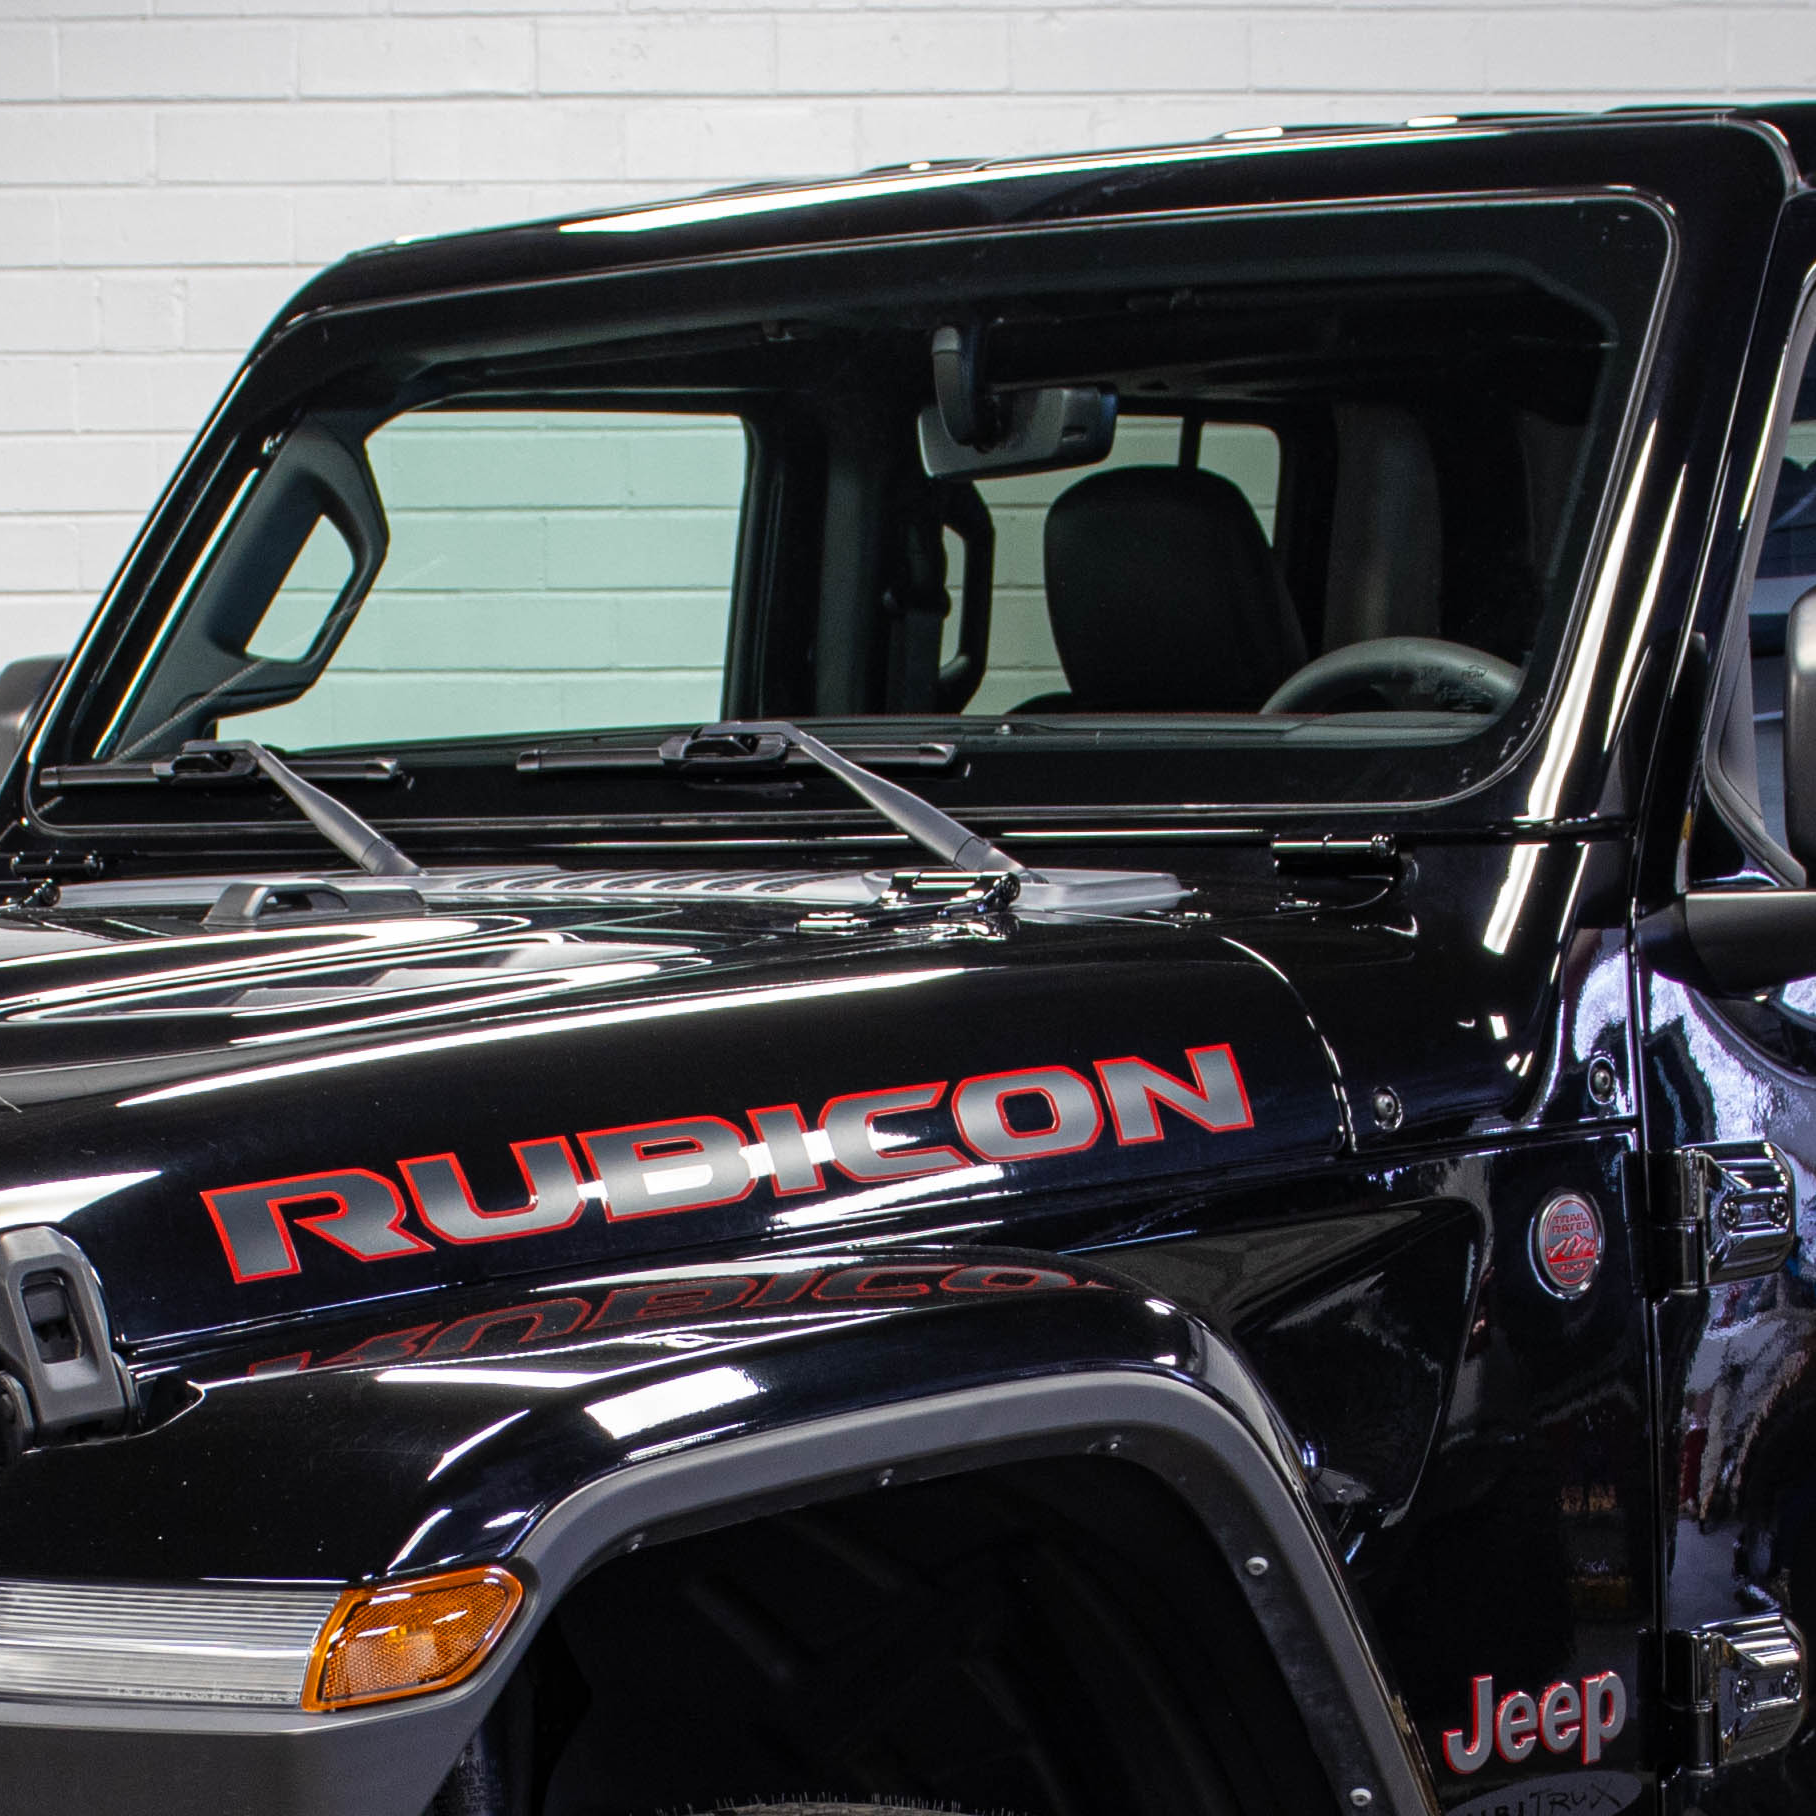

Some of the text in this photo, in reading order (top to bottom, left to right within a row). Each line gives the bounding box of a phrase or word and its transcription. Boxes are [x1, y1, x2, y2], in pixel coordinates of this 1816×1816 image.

[201, 1042, 1256, 1284] RUBICON
[1552, 1222, 1589, 1234] RATED
[1553, 1213, 1587, 1223] TRAIL
[1442, 1670, 1627, 1774] Jeep
